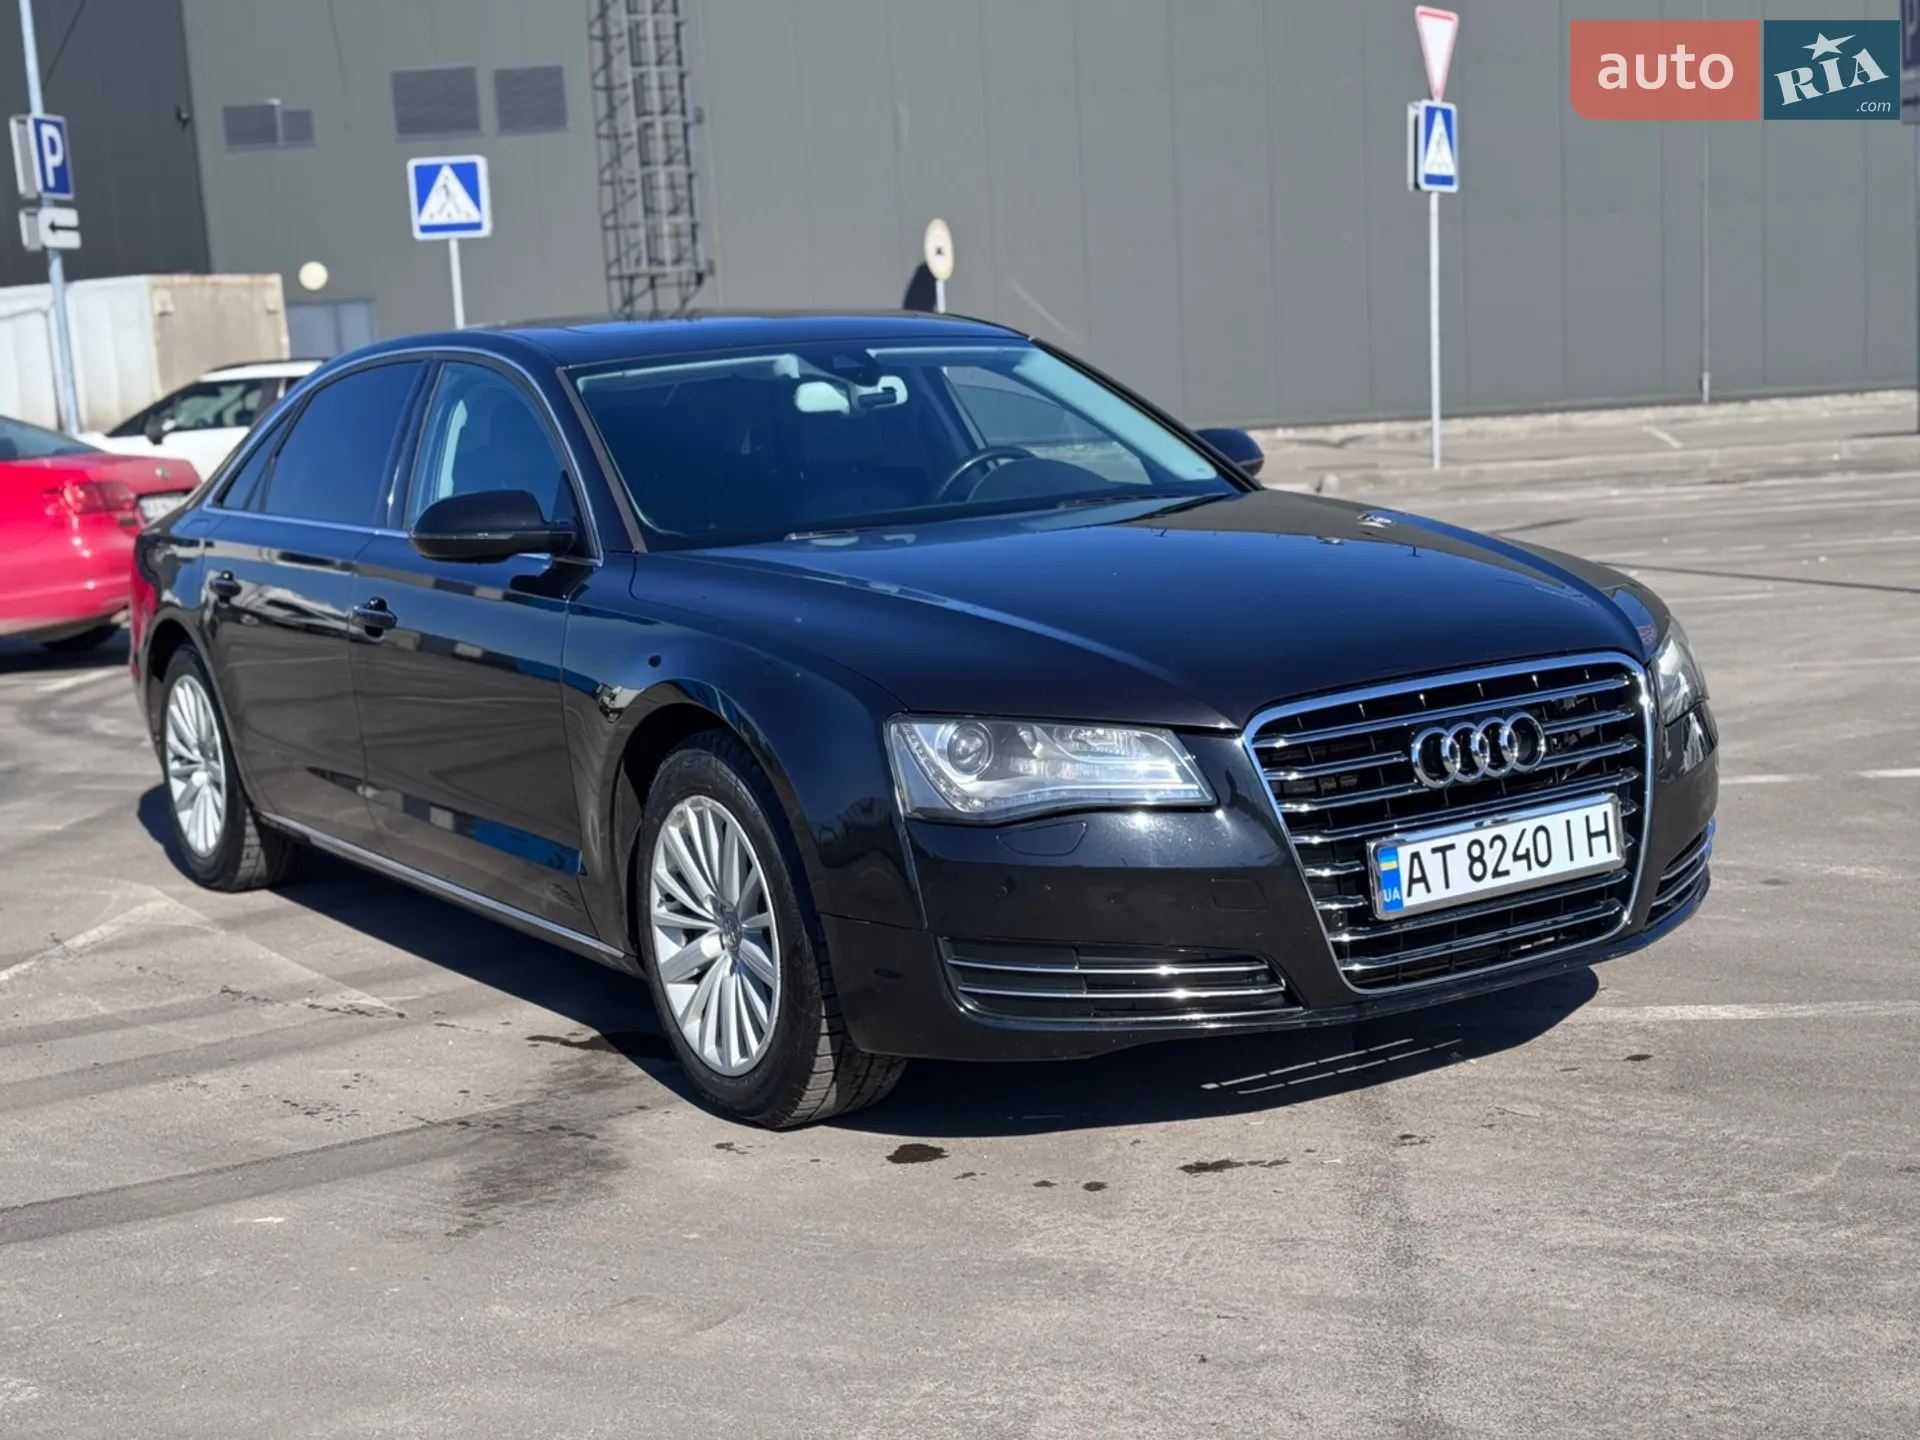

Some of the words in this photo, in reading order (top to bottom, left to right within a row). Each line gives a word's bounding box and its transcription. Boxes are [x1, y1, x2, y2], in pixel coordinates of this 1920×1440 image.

[40, 123, 64, 189] P
[1407, 843, 1456, 898] AT
[1467, 825, 1551, 882] 8240
[1565, 811, 1612, 862] IH
[1383, 888, 1401, 903] UA
